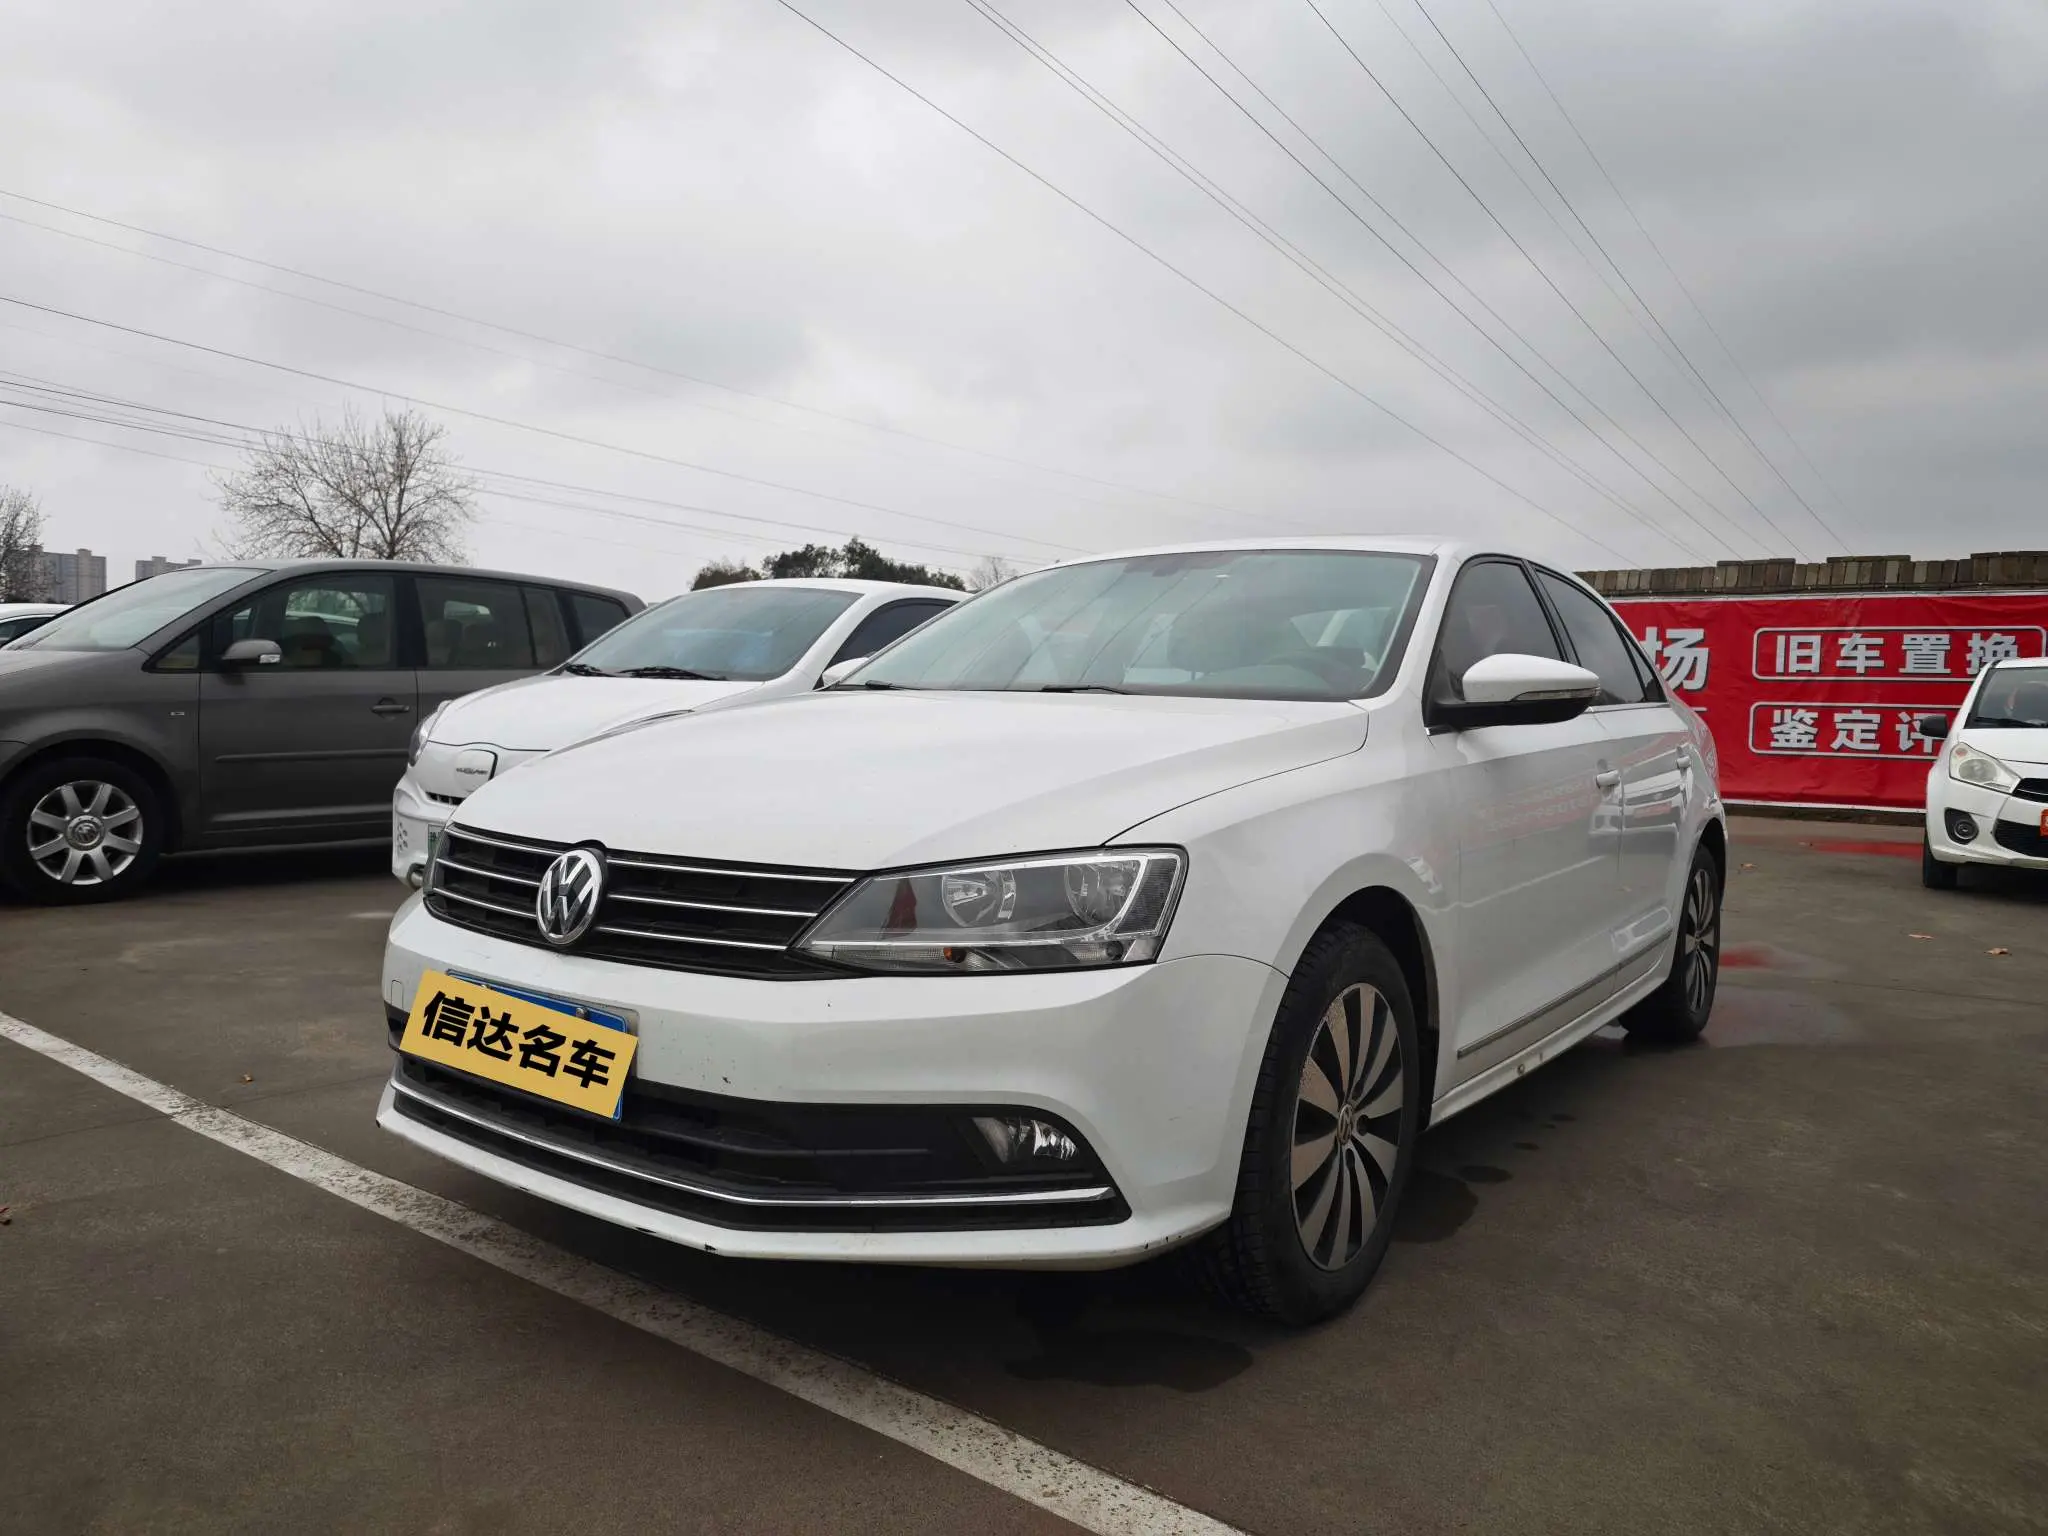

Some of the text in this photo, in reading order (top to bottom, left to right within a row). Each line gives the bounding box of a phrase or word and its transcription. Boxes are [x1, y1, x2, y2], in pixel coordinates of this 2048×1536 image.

[1639, 626, 1709, 690] 场
[1776, 632, 2018, 675] 旧车置换
